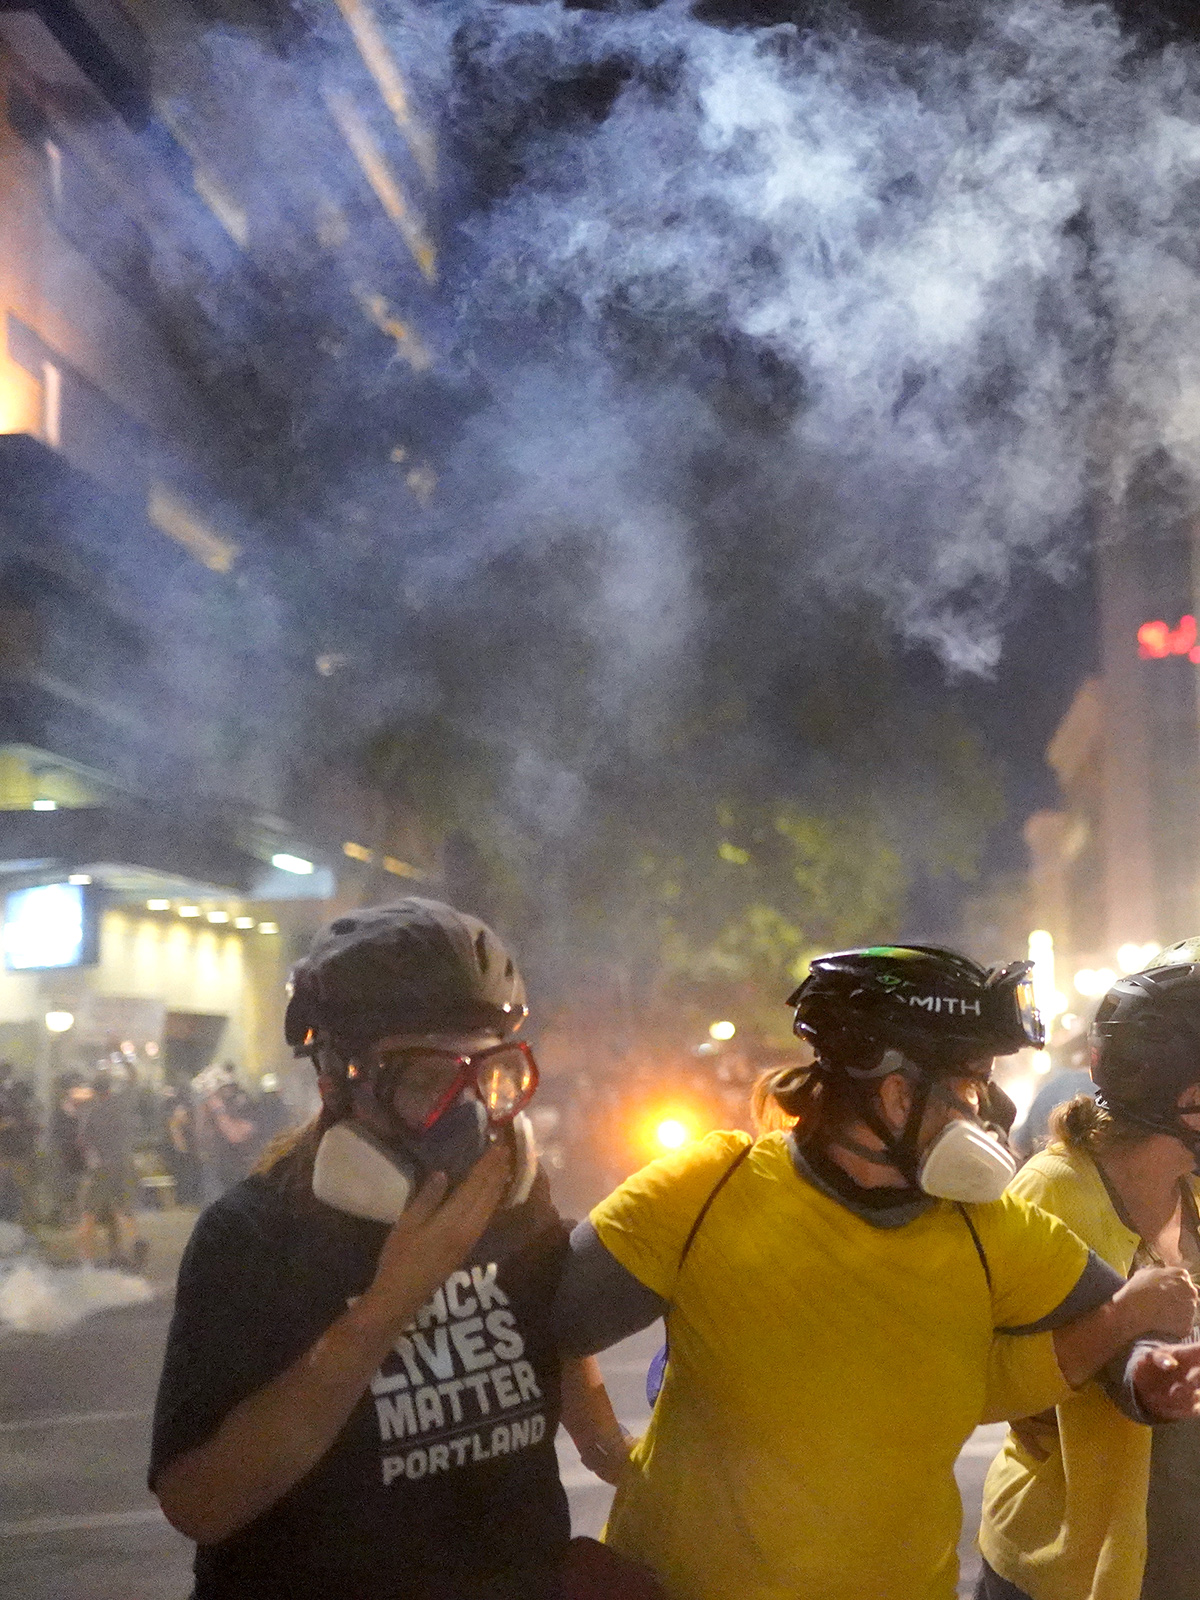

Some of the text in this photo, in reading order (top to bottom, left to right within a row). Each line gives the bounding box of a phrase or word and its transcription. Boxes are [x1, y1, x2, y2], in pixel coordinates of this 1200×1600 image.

[896, 993, 981, 1016] MITH
[403, 1261, 510, 1334] ACK
[375, 1360, 544, 1442] MATTER
[381, 1414, 547, 1486] PORTLAND
